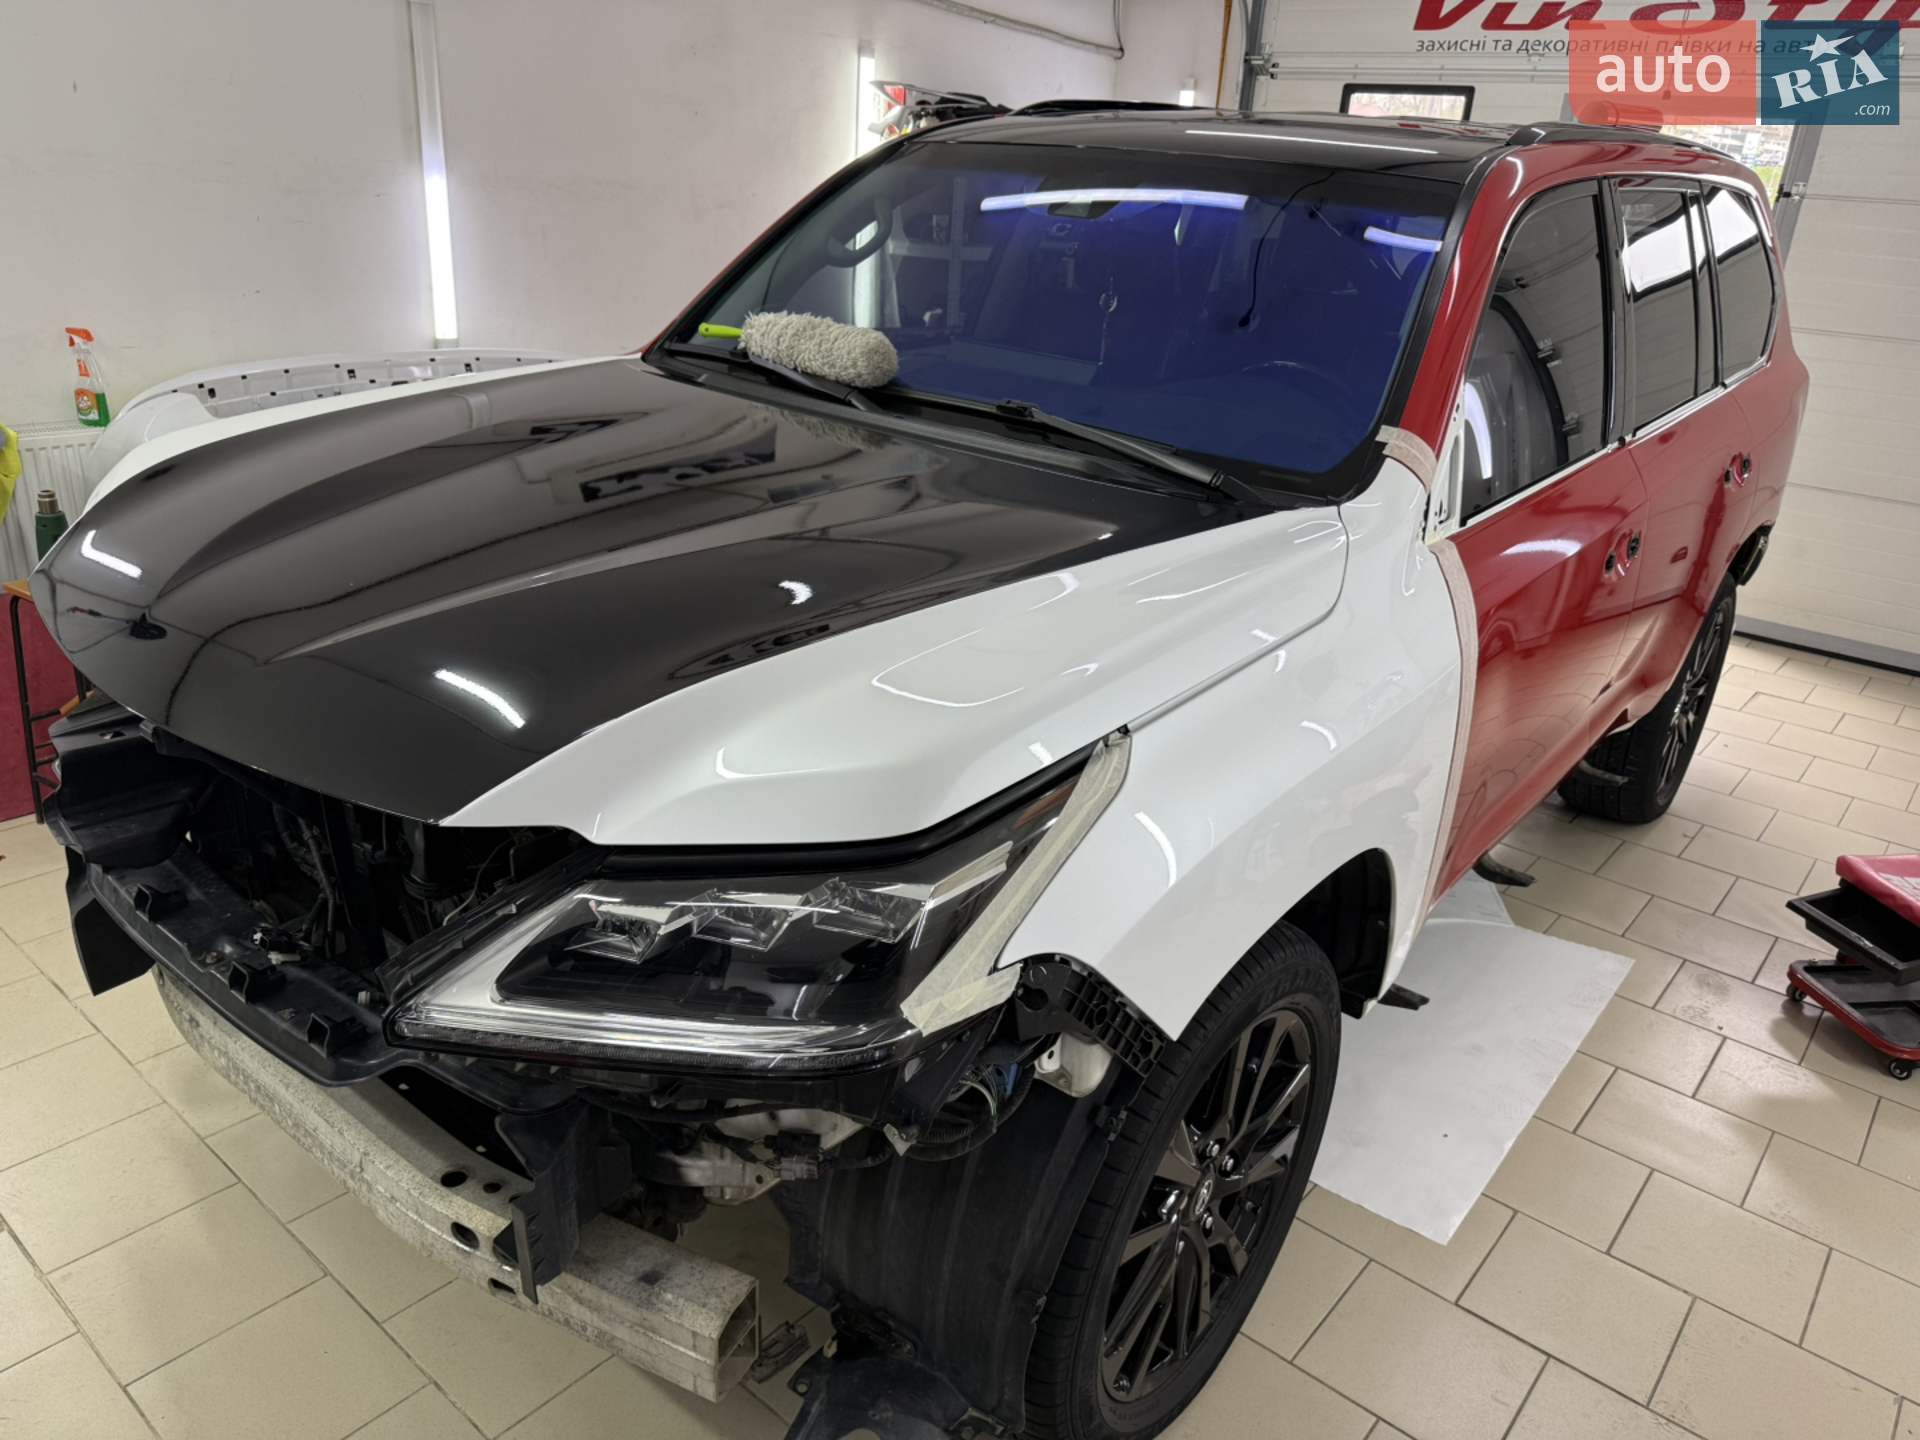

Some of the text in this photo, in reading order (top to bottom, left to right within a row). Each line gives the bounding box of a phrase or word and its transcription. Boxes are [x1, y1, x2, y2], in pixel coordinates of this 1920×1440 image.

[1415, 35, 1829, 56] захисні та декоративні плівки на авто
